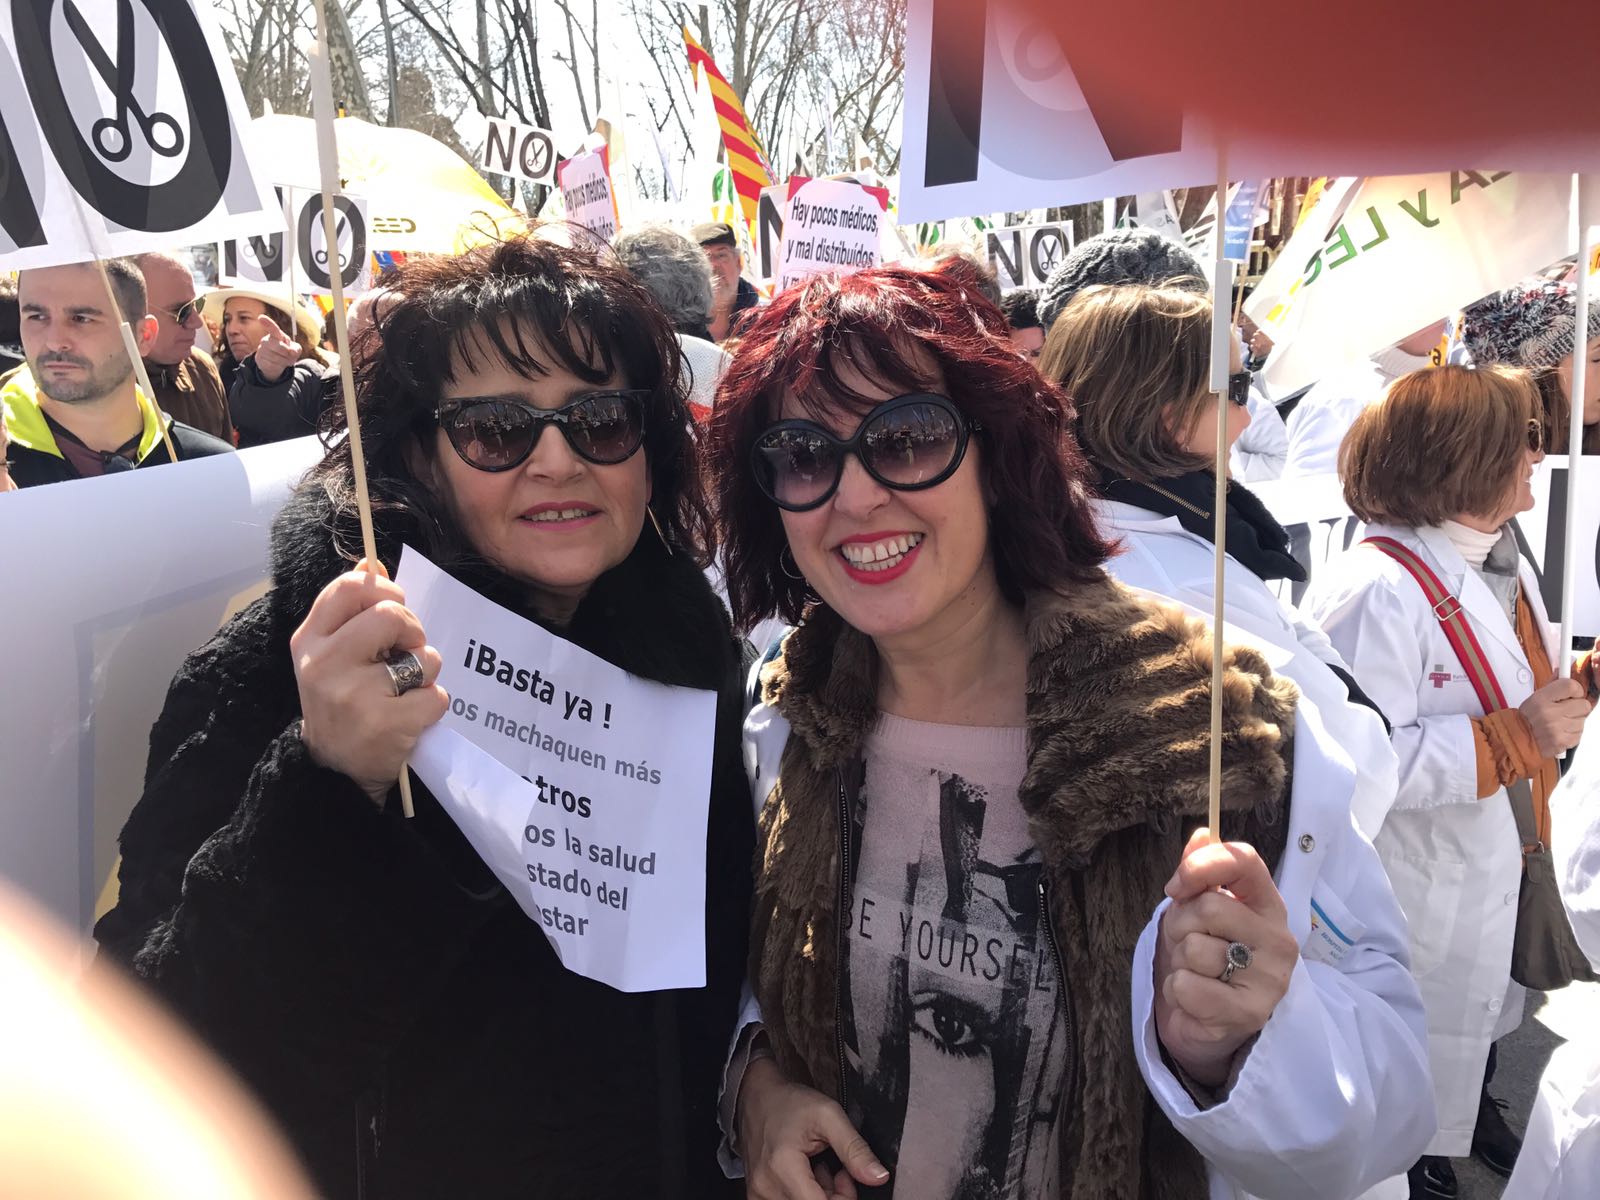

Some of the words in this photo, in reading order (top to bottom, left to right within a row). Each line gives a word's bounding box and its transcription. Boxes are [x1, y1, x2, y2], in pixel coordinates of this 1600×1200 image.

[484, 121, 553, 179] NO
[791, 196, 810, 229] Hay
[809, 206, 838, 229] pocos
[839, 204, 879, 238] médicos,
[785, 238, 794, 264] y
[794, 236, 815, 261] mal
[815, 239, 875, 268] distribuídos
[986, 227, 1071, 287] NO
[563, 691, 593, 723] ya
[603, 702, 612, 730] !
[484, 710, 606, 771] machaquen
[614, 760, 662, 786] más
[522, 775, 592, 819] tros
[524, 824, 556, 848] os
[565, 827, 582, 856] la
[588, 845, 656, 875] salud
[526, 862, 592, 897] stado
[597, 881, 628, 911] del
[536, 904, 589, 936] star
[847, 897, 875, 940] E
[900, 912, 1051, 993] YOURSEL
